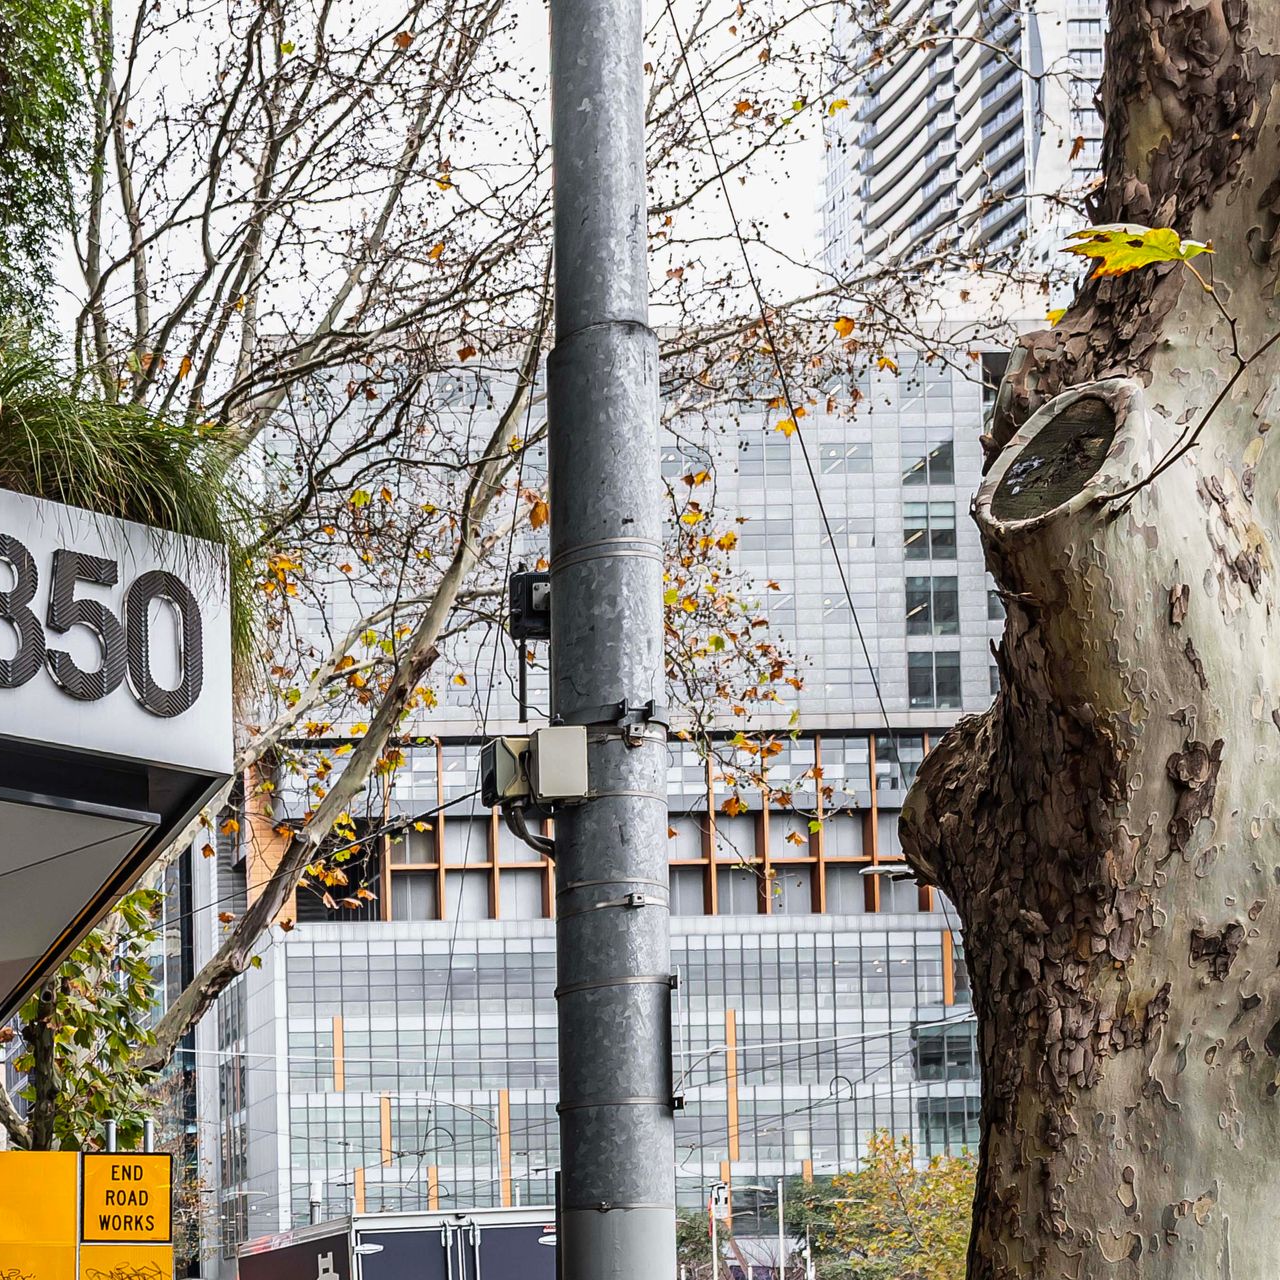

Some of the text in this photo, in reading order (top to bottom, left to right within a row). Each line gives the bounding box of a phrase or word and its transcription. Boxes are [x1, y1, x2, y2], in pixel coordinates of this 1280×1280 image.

[111, 1165, 143, 1181] END
[105, 1190, 149, 1206] ROAD
[99, 1215, 155, 1231] WORKS
